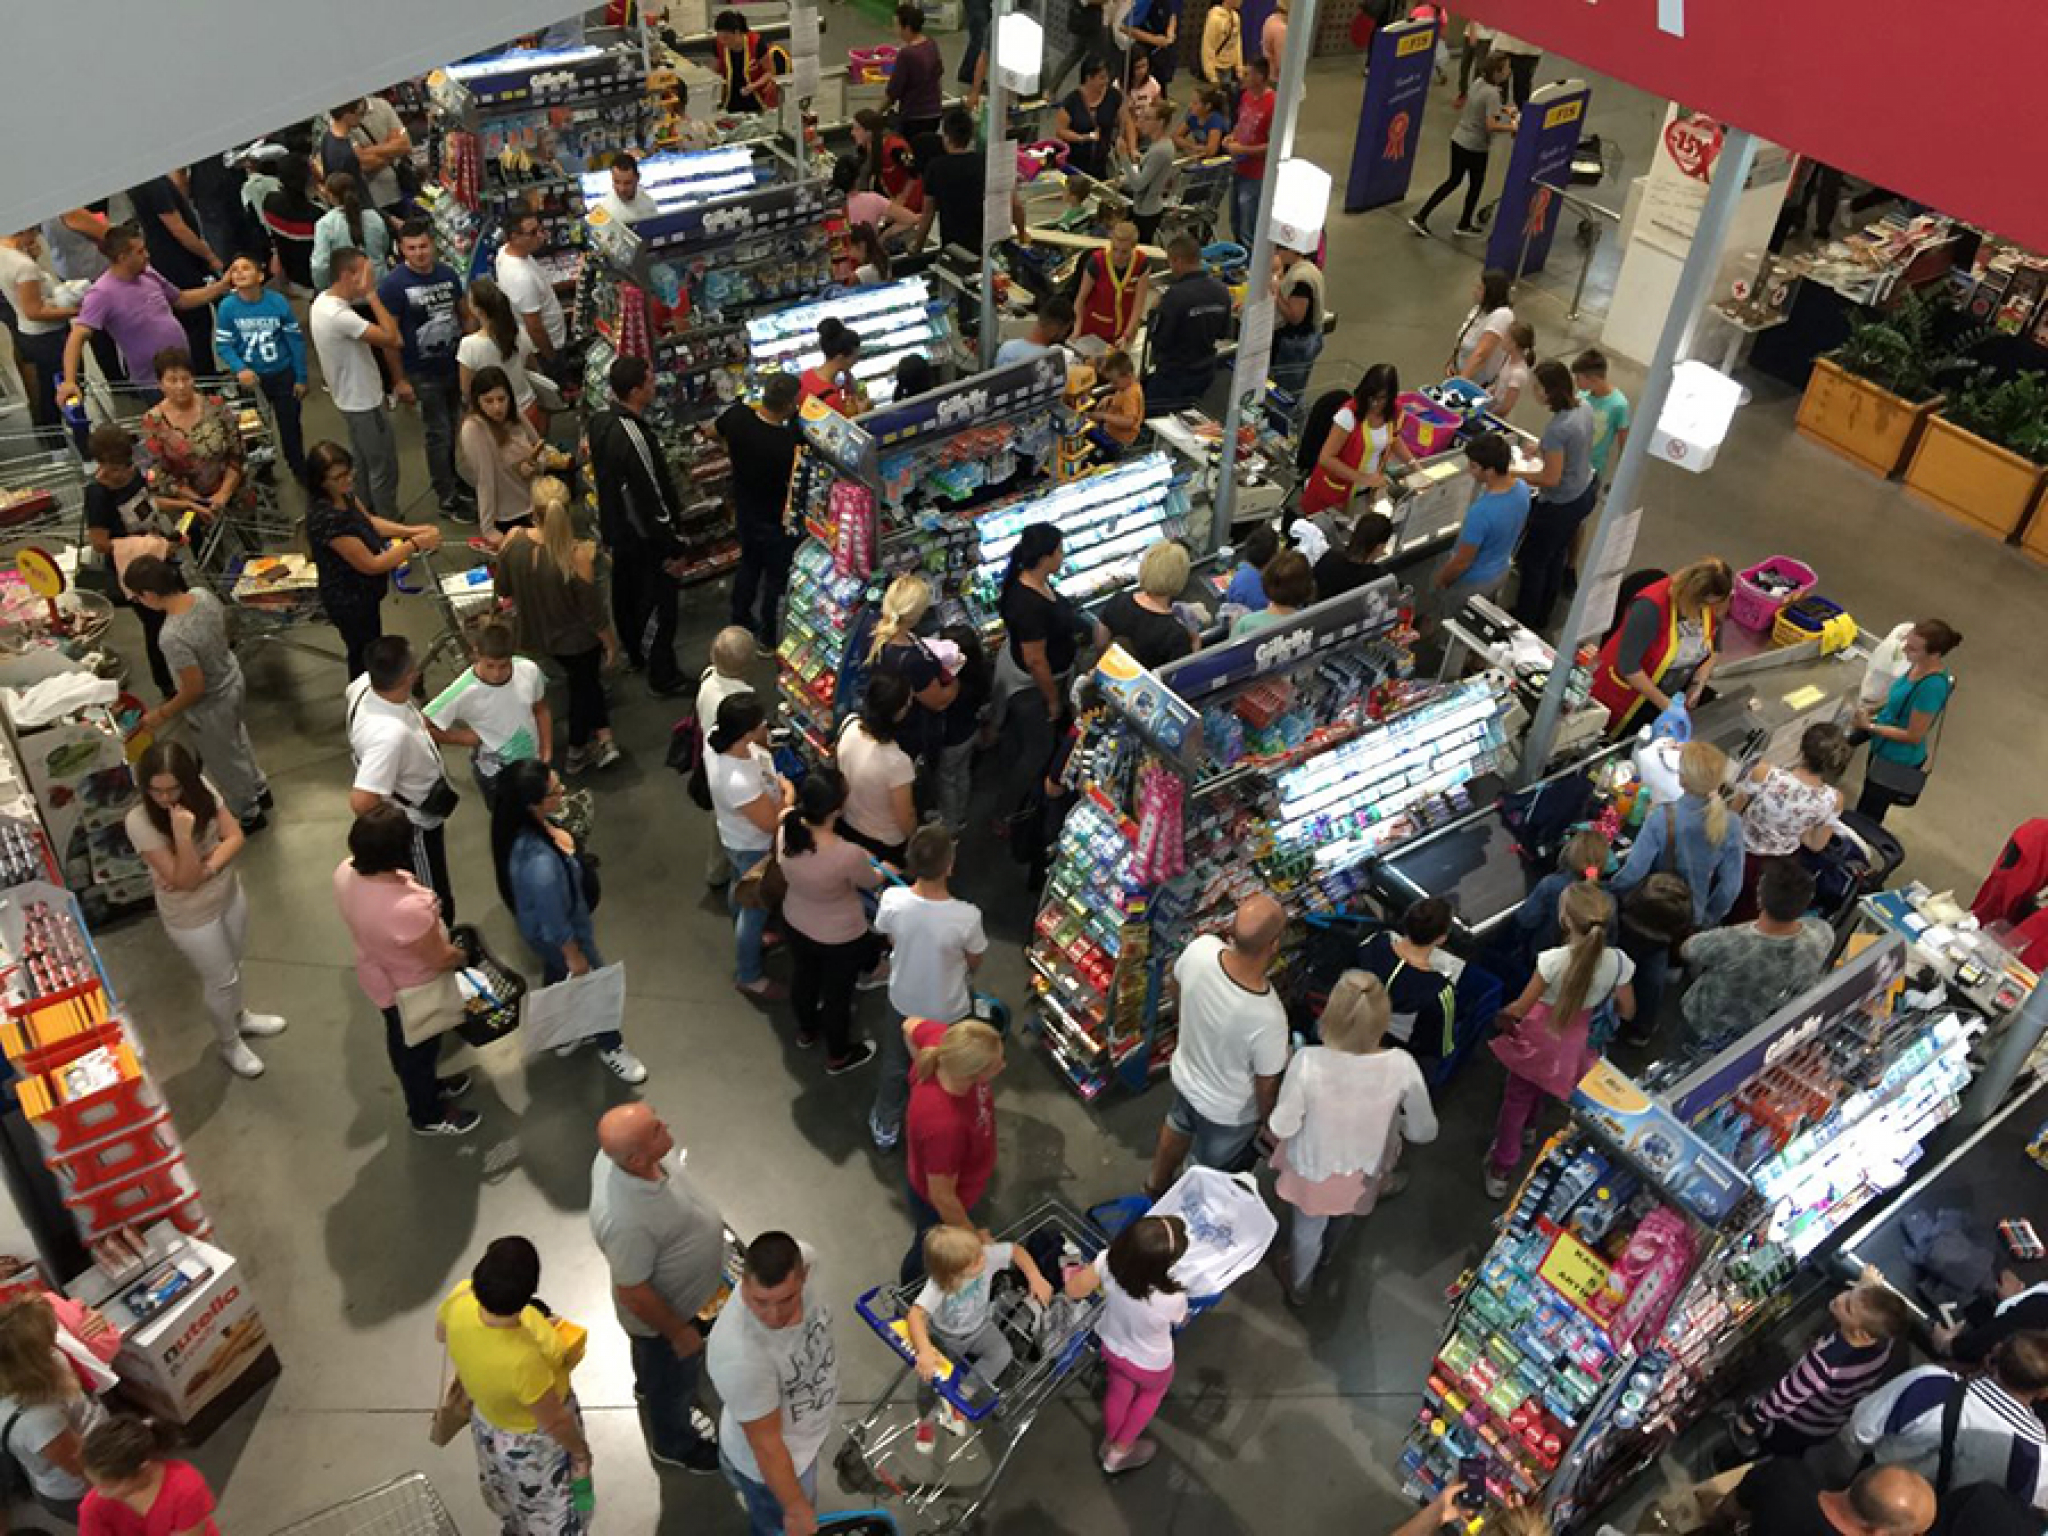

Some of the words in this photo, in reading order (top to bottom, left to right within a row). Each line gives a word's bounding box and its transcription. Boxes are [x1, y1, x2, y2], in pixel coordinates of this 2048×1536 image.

[241, 331, 279, 362] 76
[1256, 628, 1314, 668] Gillette
[163, 1285, 240, 1364] nutella
